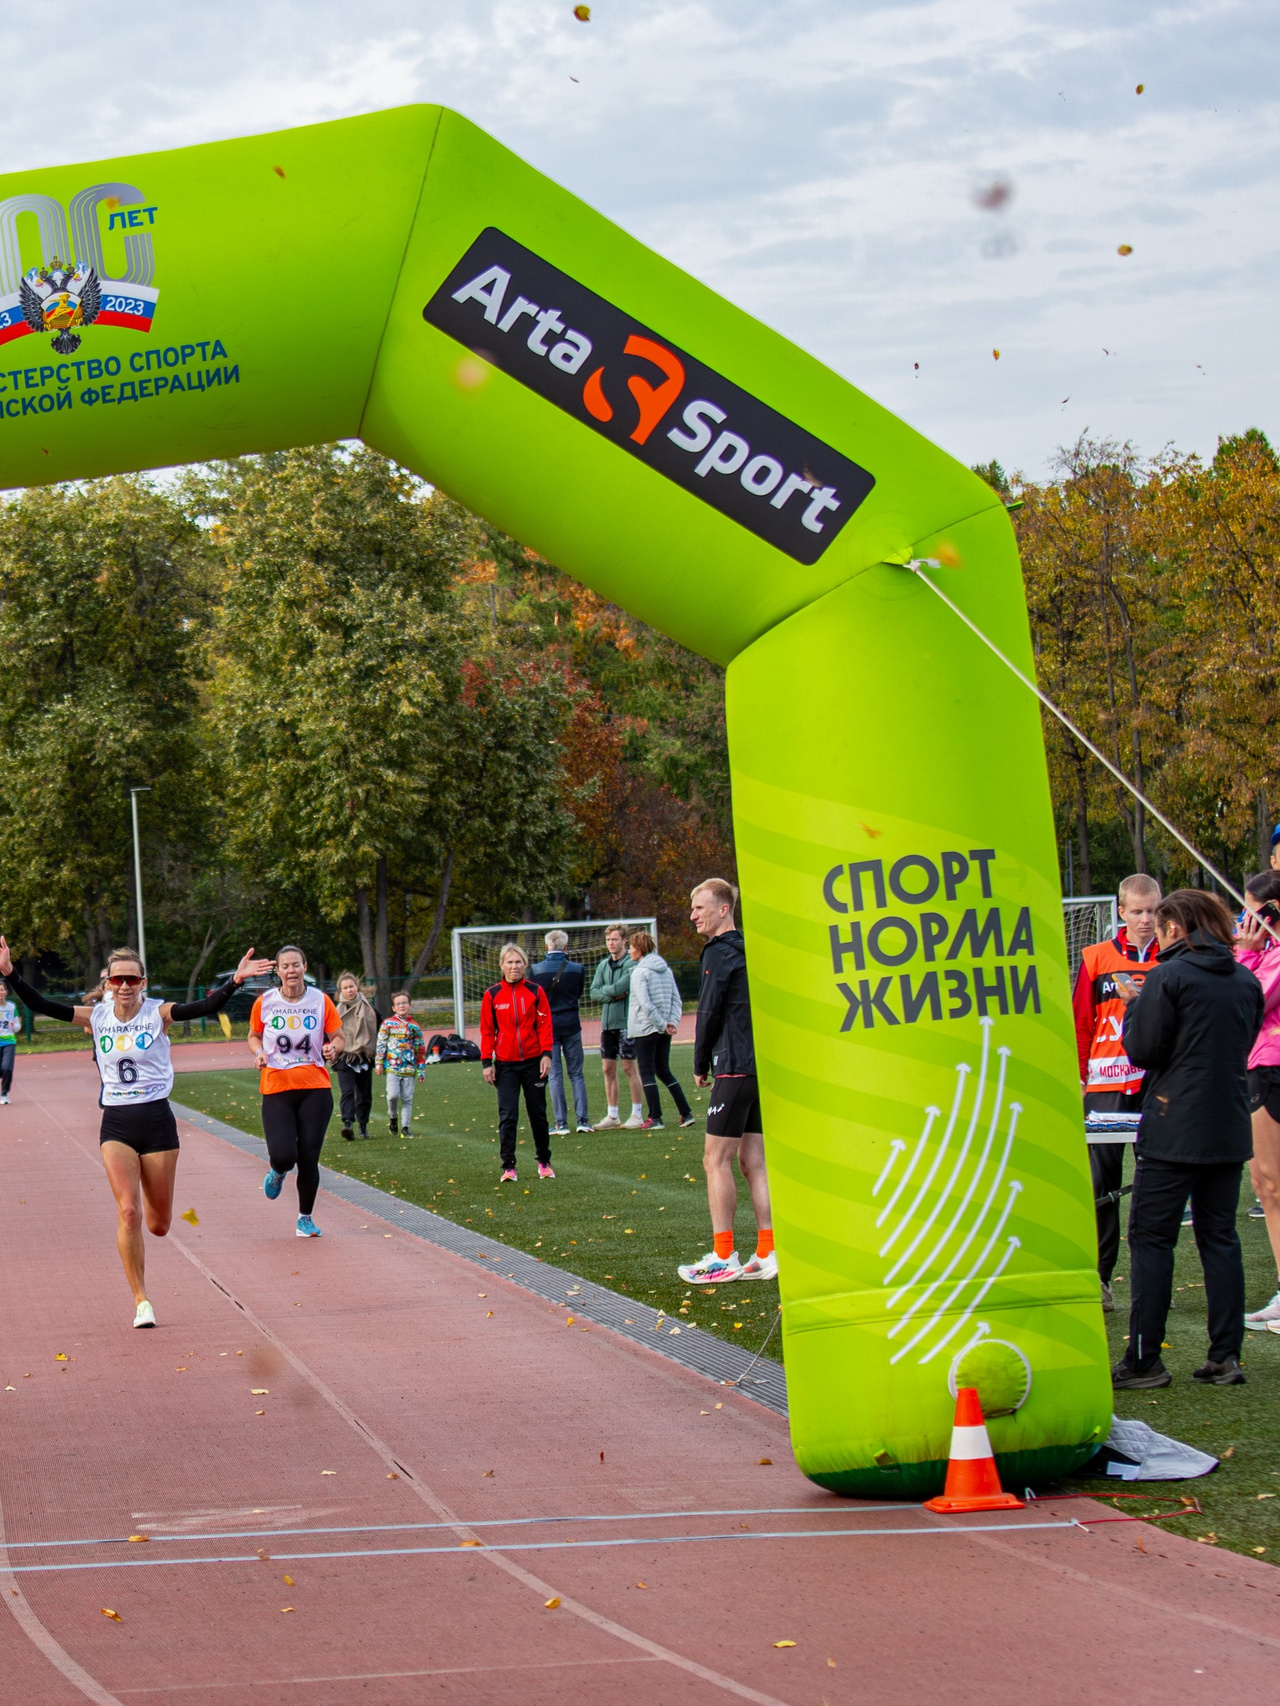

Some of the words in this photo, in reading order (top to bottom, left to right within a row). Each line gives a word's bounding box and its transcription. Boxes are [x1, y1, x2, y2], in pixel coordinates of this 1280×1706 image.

[107, 206, 159, 231] ЛЕТ
[105, 296, 145, 316] 2023
[128, 338, 229, 371] СПОРТА
[79, 364, 241, 407] ФЕДЕРАЦИИ
[450, 264, 593, 376] Arta
[666, 398, 842, 534] Sport
[822, 848, 996, 914] СПОРТ
[828, 906, 1035, 975] НОРМА
[835, 964, 1042, 1033] ЖИЗНИ
[98, 1022, 154, 1034] VMARAFONE
[276, 1034, 313, 1055] 94
[117, 1056, 139, 1085] 6
